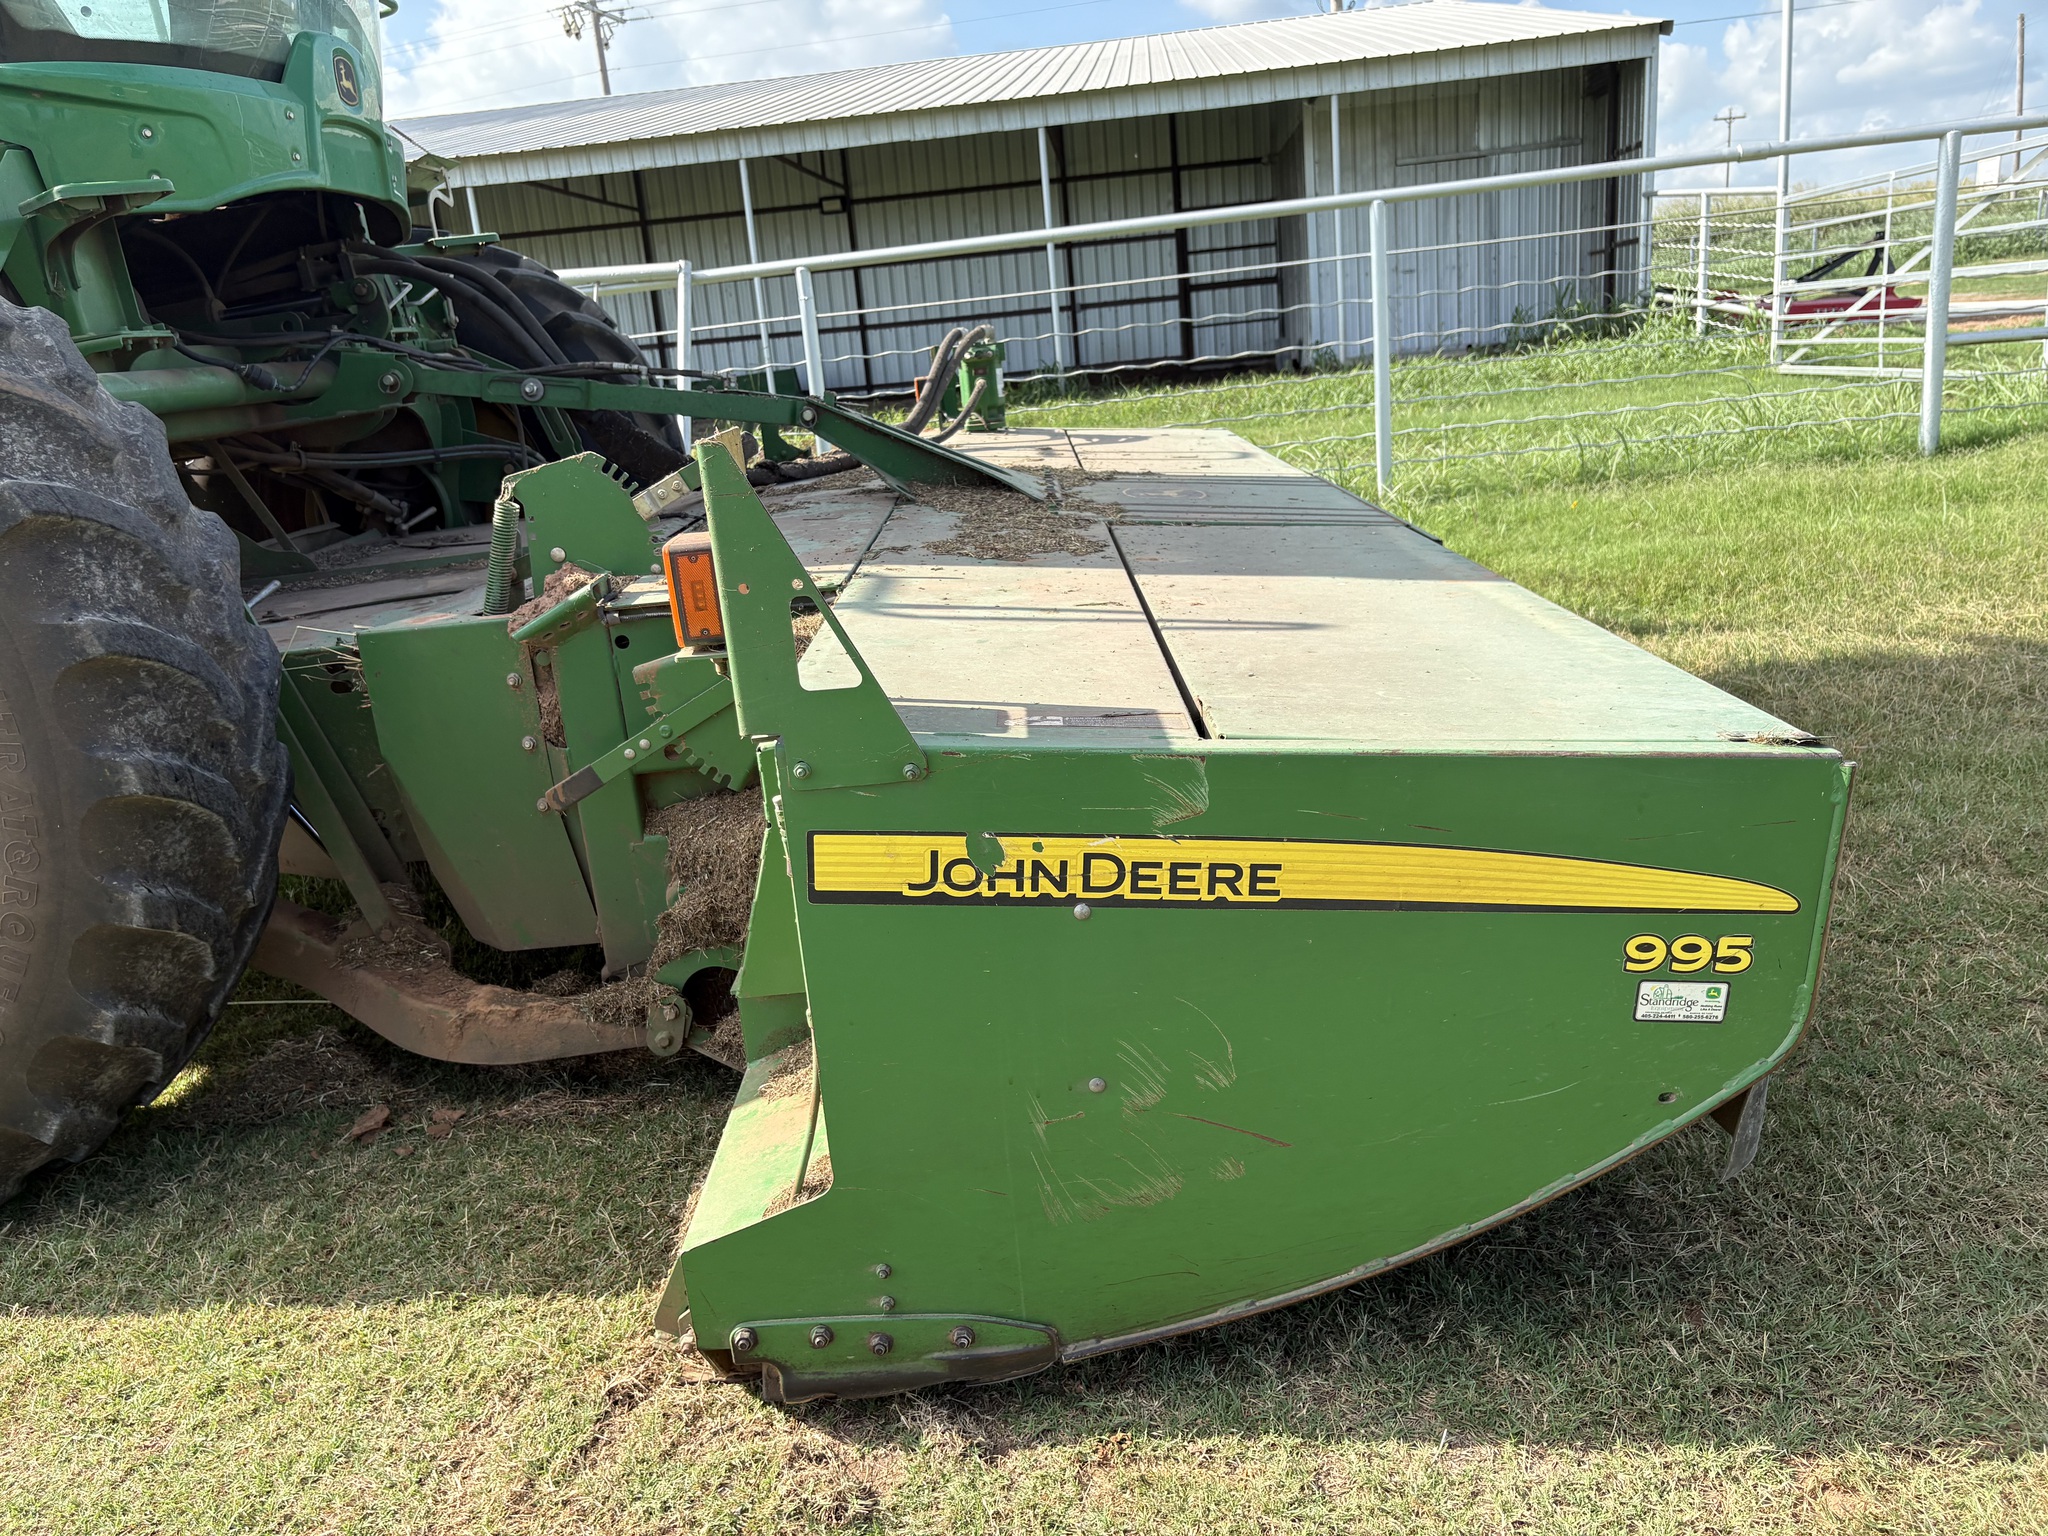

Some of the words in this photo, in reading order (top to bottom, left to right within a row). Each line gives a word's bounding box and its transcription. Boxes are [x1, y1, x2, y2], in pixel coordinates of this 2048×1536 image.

[907, 849, 1069, 893] JOHN
[1082, 852, 1283, 897] DEERE
[1624, 934, 1753, 973] 995
[1639, 993, 1699, 1012] Standridge
